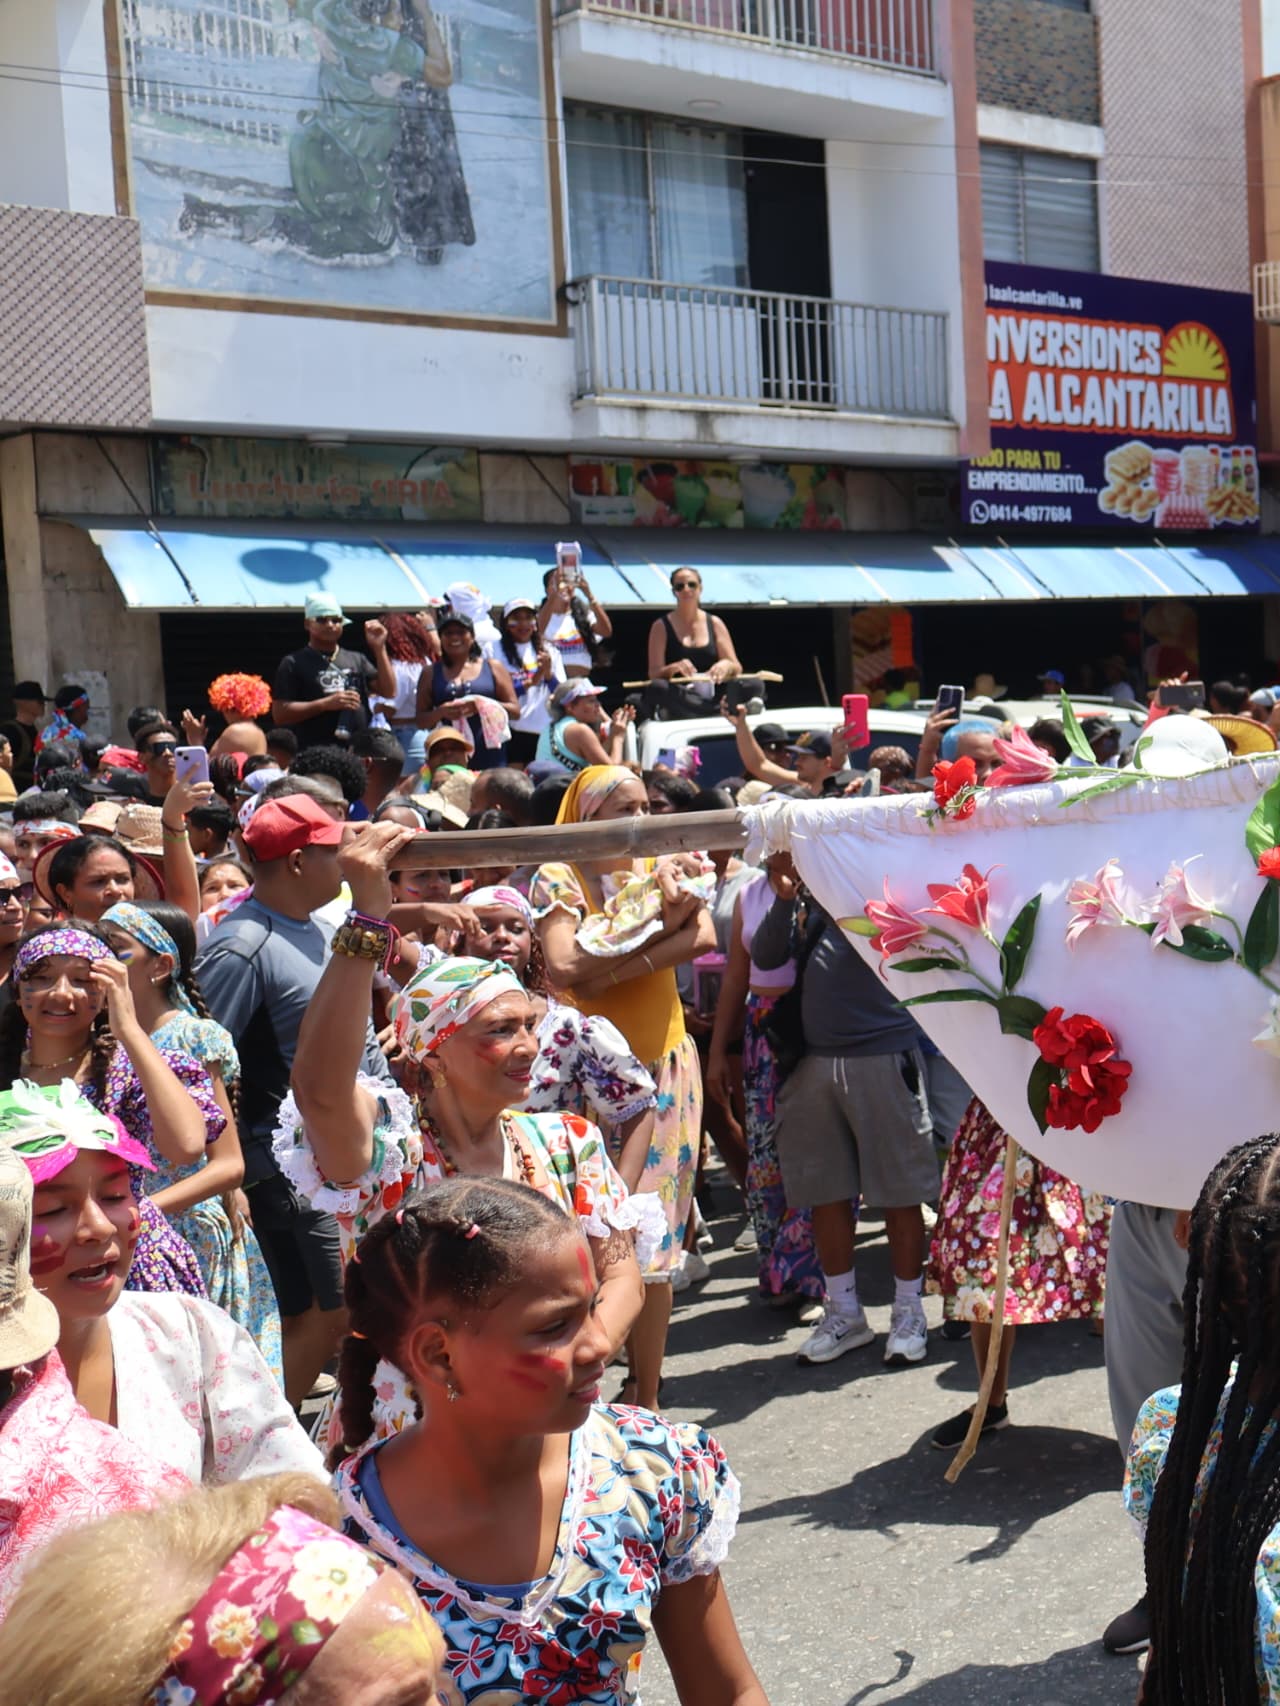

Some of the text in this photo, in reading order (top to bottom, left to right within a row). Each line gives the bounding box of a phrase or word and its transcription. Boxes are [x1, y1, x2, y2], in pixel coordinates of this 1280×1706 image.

[989, 284, 1083, 310] laalcantarilla.ve
[988, 369, 1232, 435] A ALCANTARILLA
[1006, 449, 1042, 469] PARA
[1043, 451, 1061, 470] TU
[371, 478, 455, 508] SIRIA
[968, 470, 1098, 494] EMPRENDIMIENTO...
